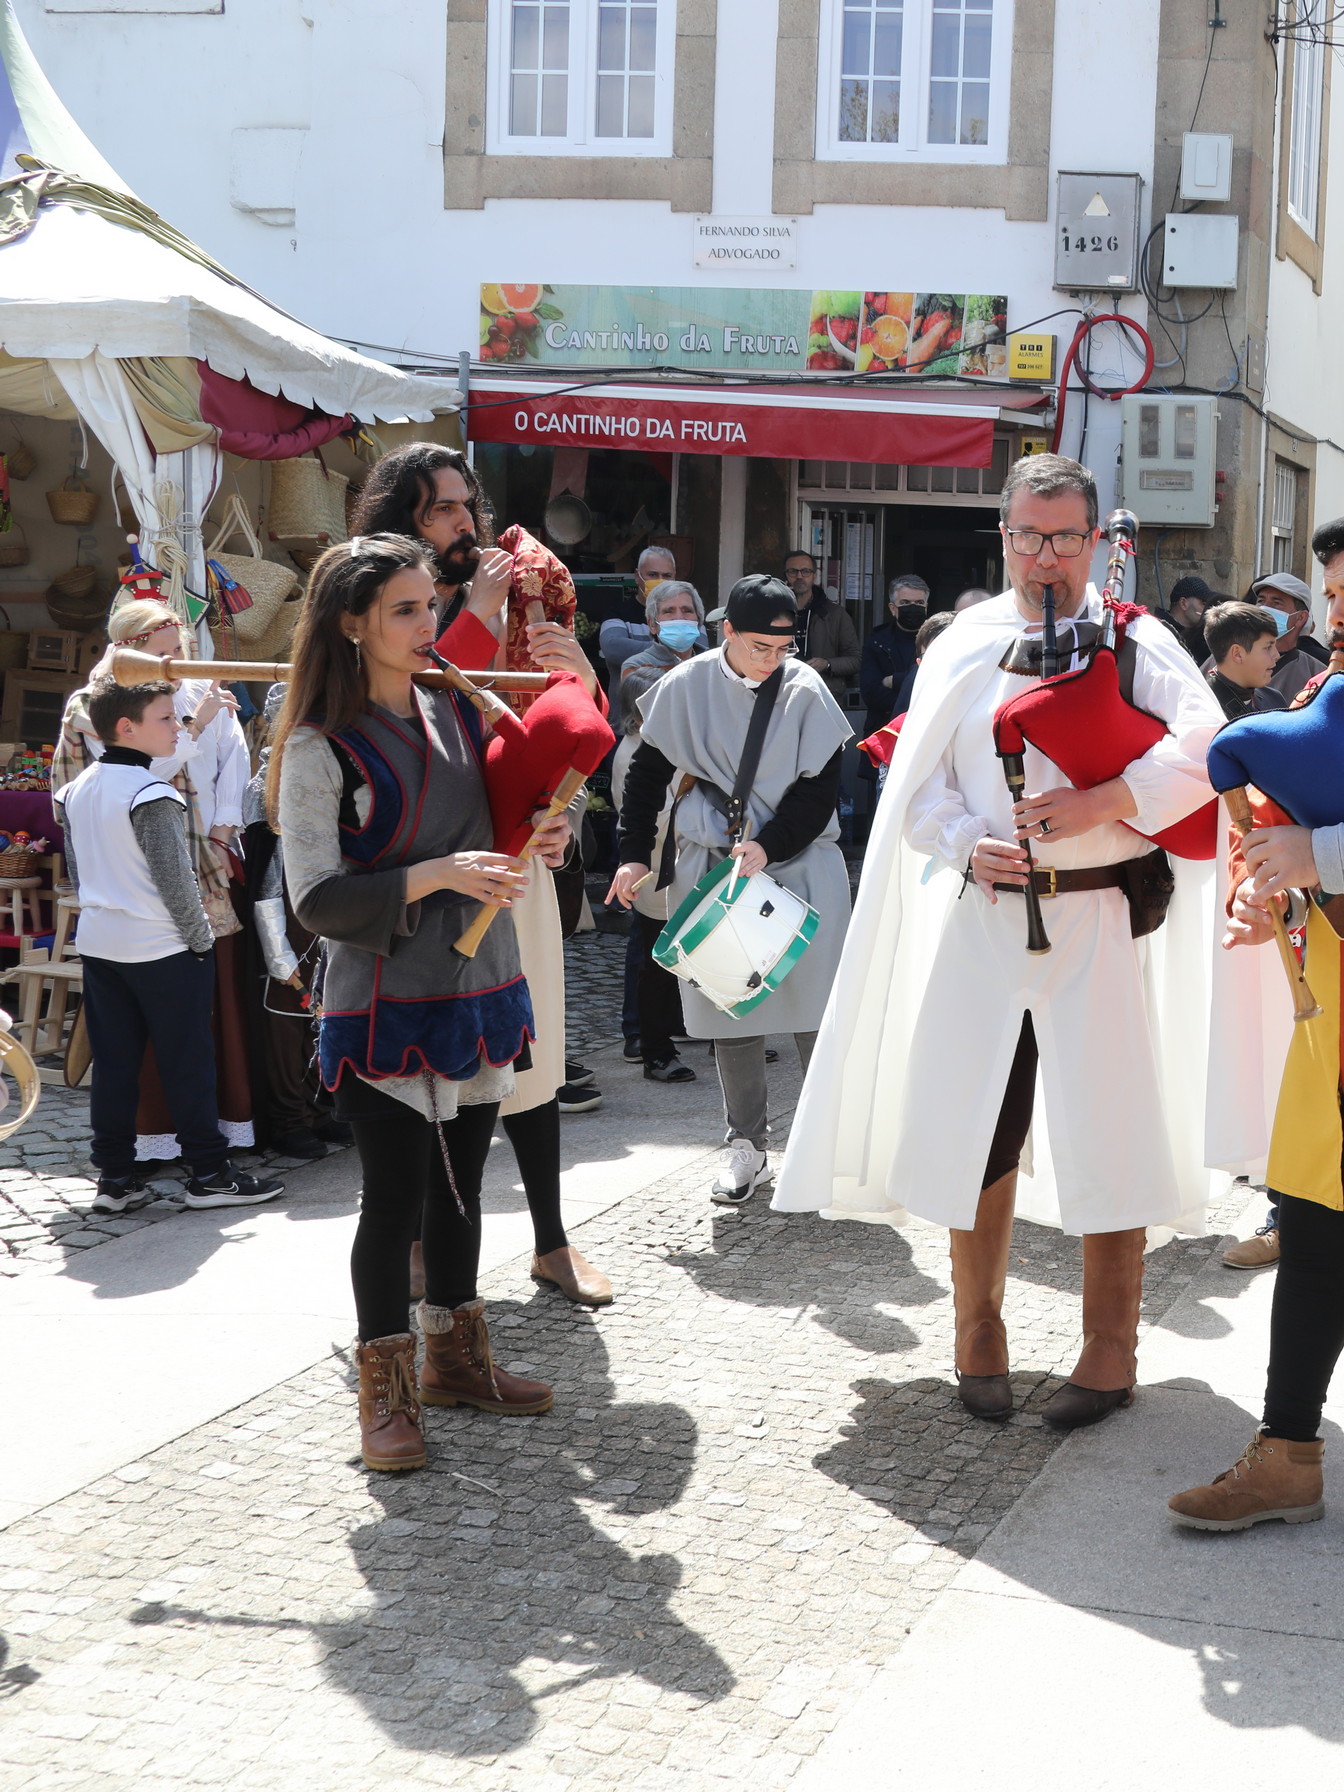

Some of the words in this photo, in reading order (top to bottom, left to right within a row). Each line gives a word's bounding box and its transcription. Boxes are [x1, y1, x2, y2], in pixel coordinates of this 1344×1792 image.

[699, 225, 760, 237] FERNANDO
[762, 227, 792, 238] SILVA
[1062, 236, 1119, 252] 1426
[708, 247, 780, 260] ADVOGADO
[679, 323, 713, 353] da
[514, 411, 528, 431] O
[533, 411, 641, 438] CANTINHO
[646, 417, 675, 440] DA
[680, 419, 748, 443] FRUTA
